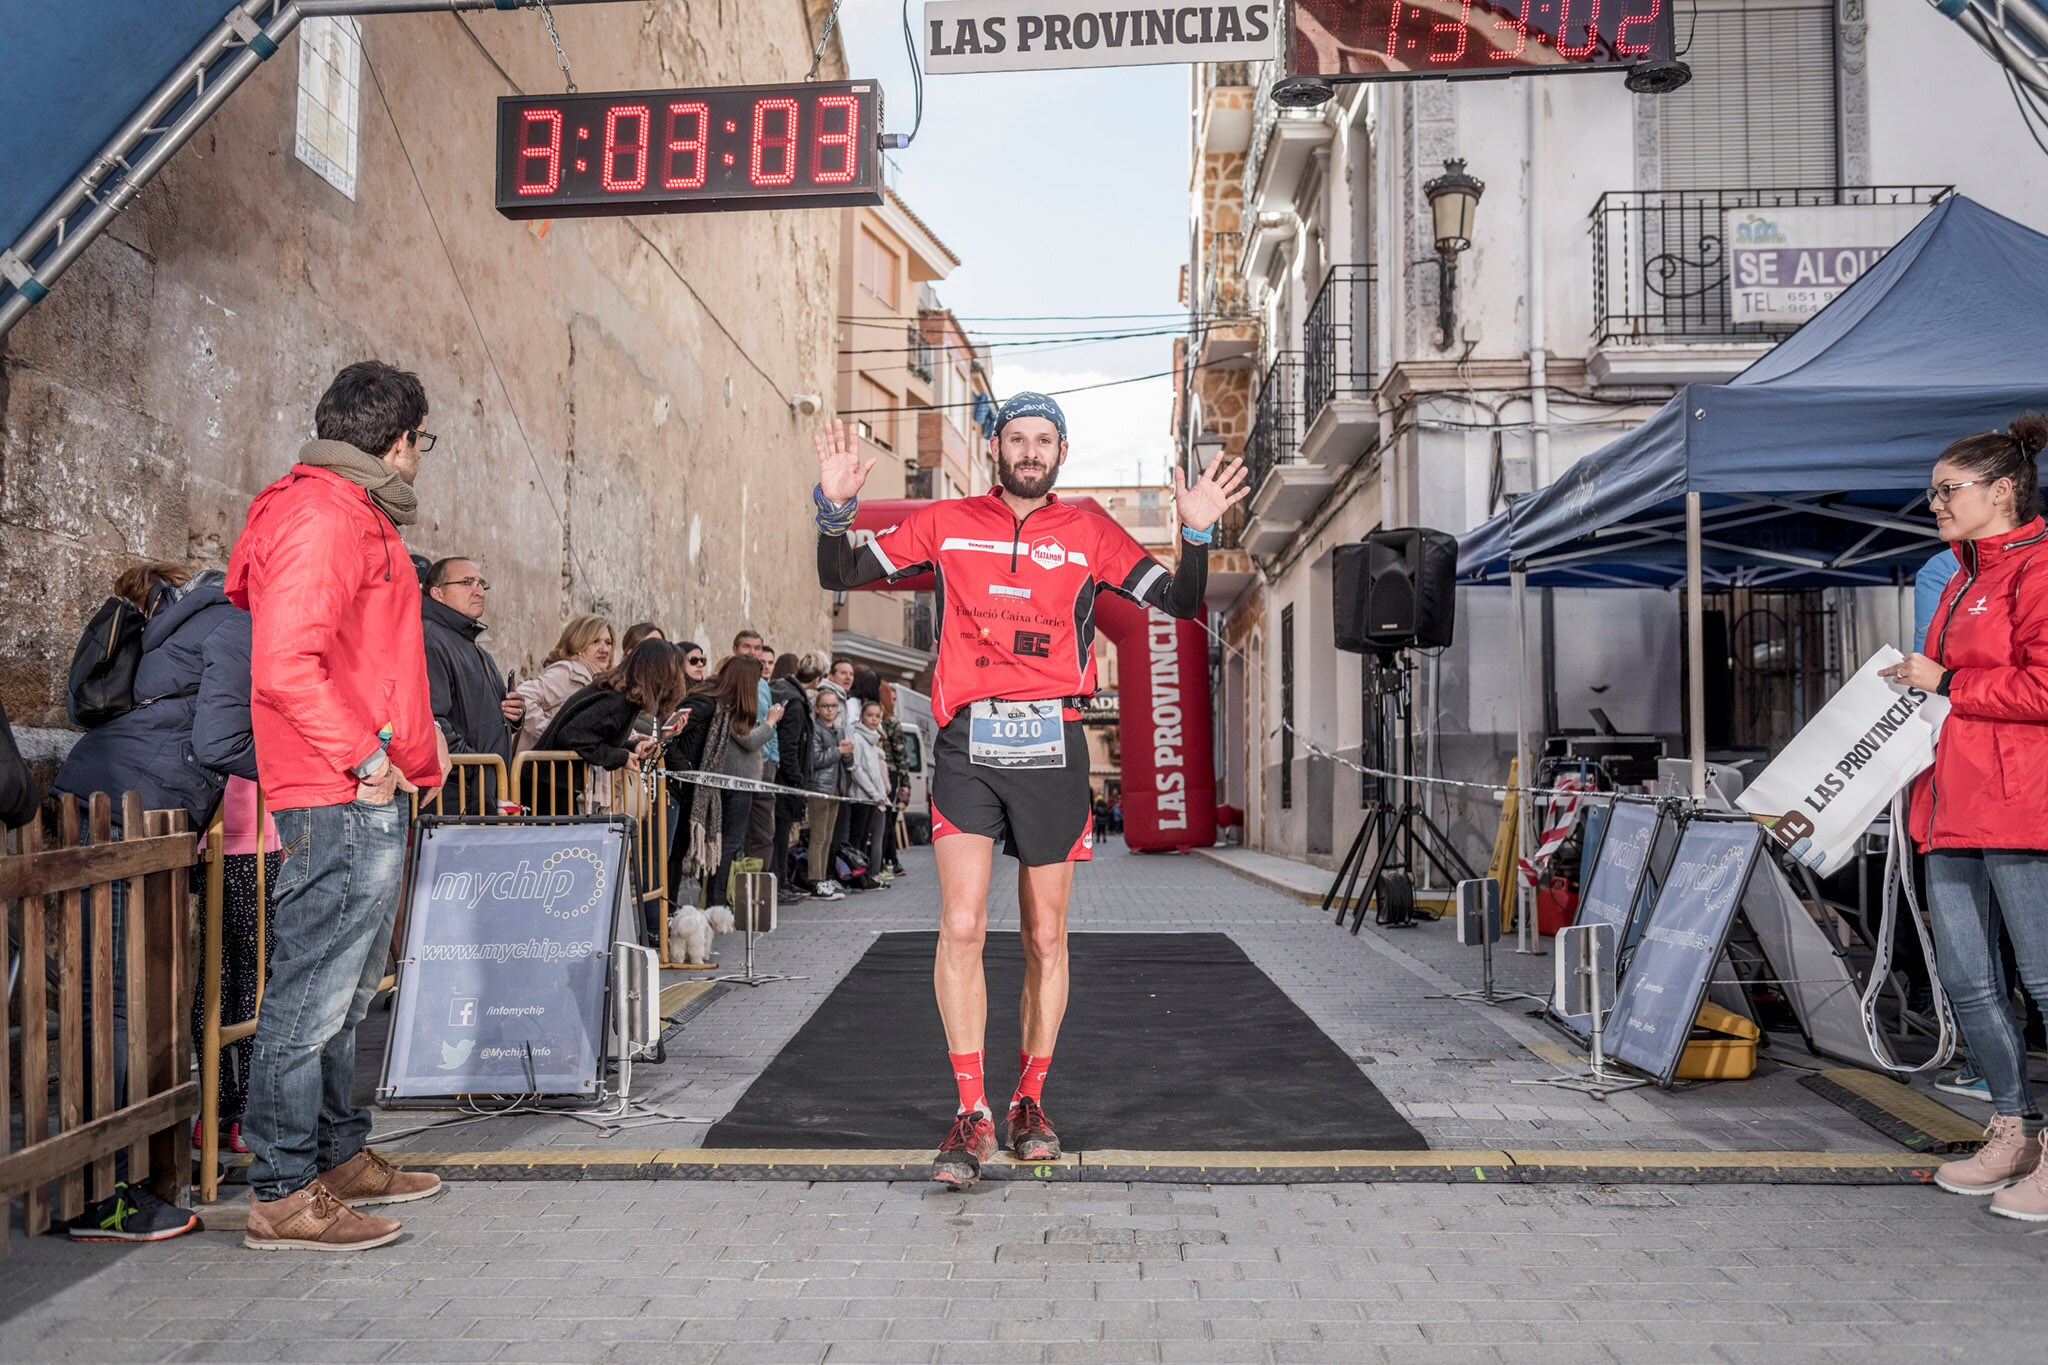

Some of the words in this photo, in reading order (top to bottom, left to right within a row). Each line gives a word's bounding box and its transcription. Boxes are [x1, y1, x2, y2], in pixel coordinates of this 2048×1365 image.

[929, 17, 1007, 56] LAS
[1016, 5, 1270, 53] PROVINCIAS
[517, 95, 861, 196] 3:03:03
[1739, 251, 1778, 285] SE
[1793, 250, 1889, 285] ALQU
[1787, 292, 1817, 302] 651
[1034, 549, 1063, 562] MATAMON
[1001, 609, 1031, 623] Caixa
[1148, 605, 1184, 768] PROVINCIA
[991, 720, 1043, 739] 1010
[1803, 772, 1846, 814] LAS
[1834, 685, 1929, 781] PROVINCIAS
[1155, 772, 1188, 831] LAS
[432, 860, 575, 909] mychip
[422, 938, 594, 963] www.mychip.es
[486, 1004, 546, 1017] /infomychip
